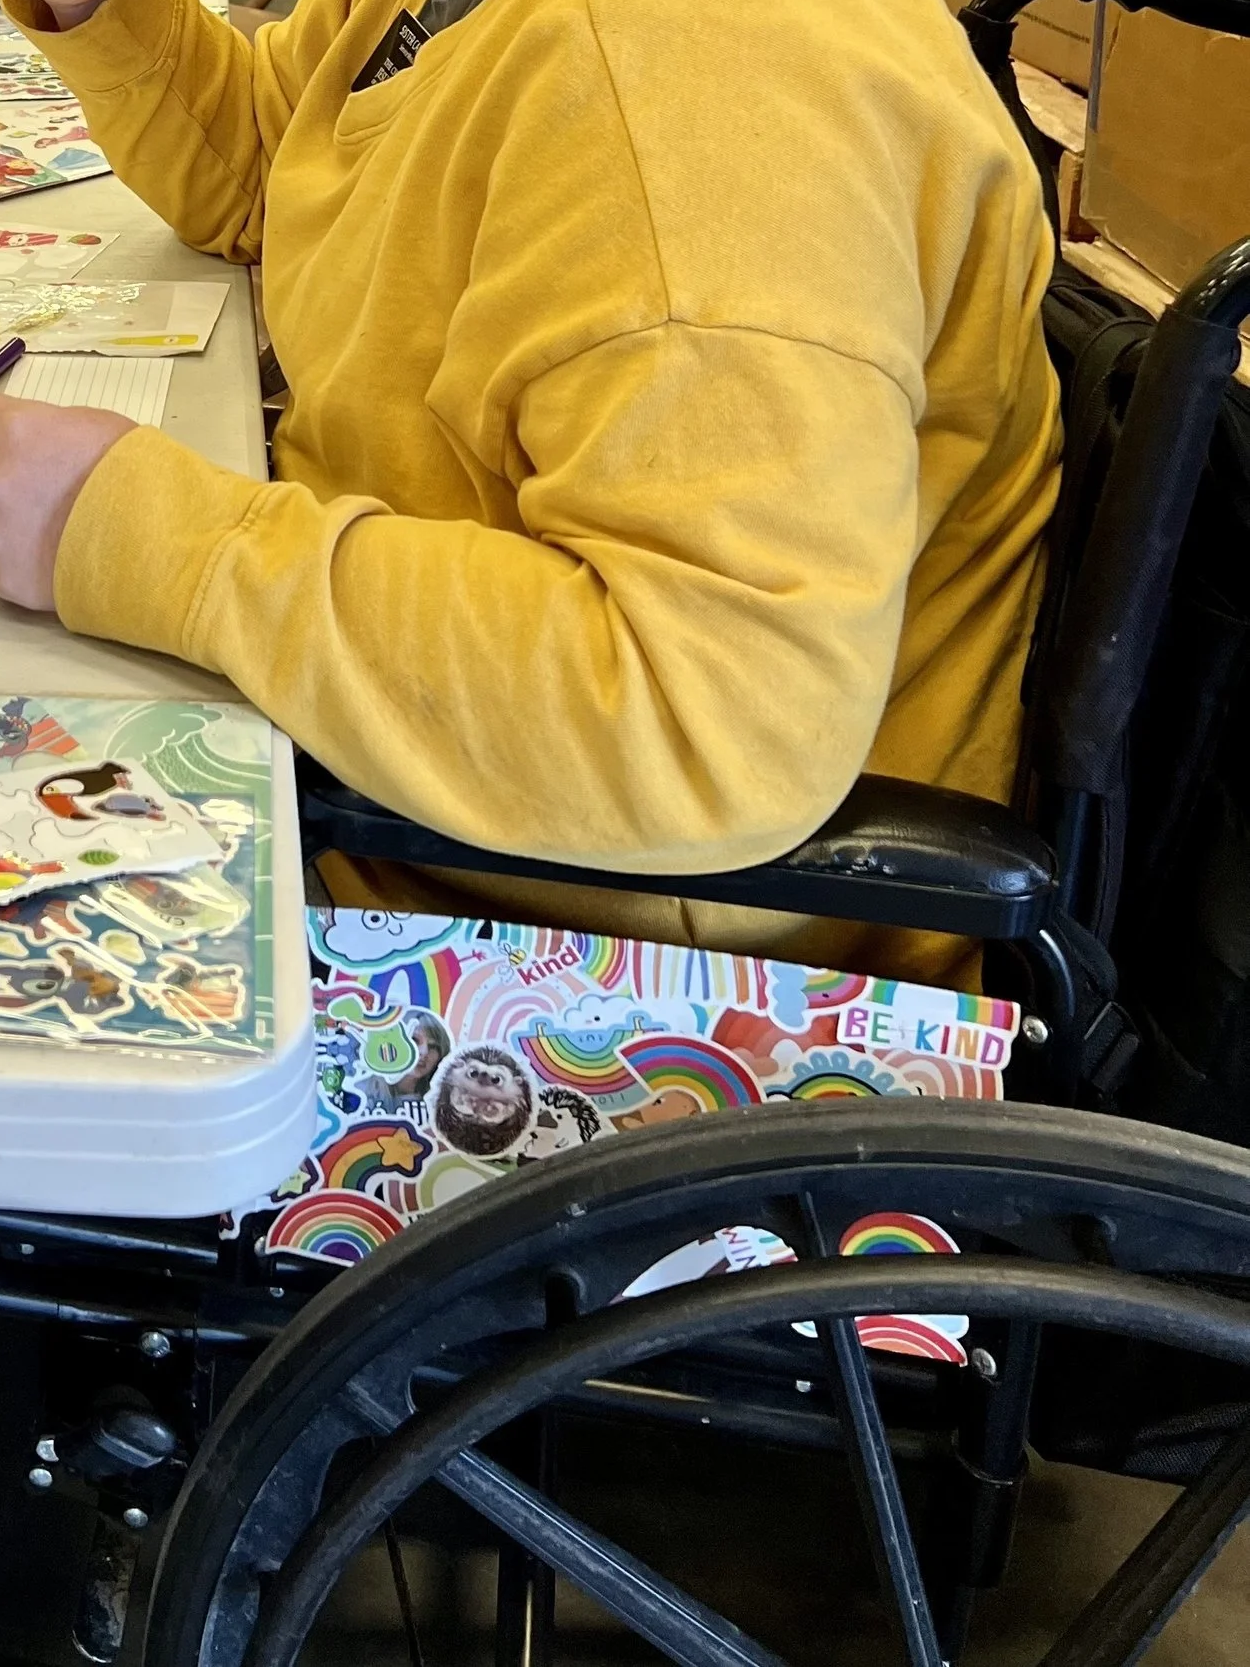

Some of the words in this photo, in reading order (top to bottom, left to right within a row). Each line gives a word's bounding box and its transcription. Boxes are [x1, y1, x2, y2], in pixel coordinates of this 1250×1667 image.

[517, 945, 580, 985] kind
[845, 1007, 893, 1044] BE
[915, 1019, 1004, 1065] KIND
